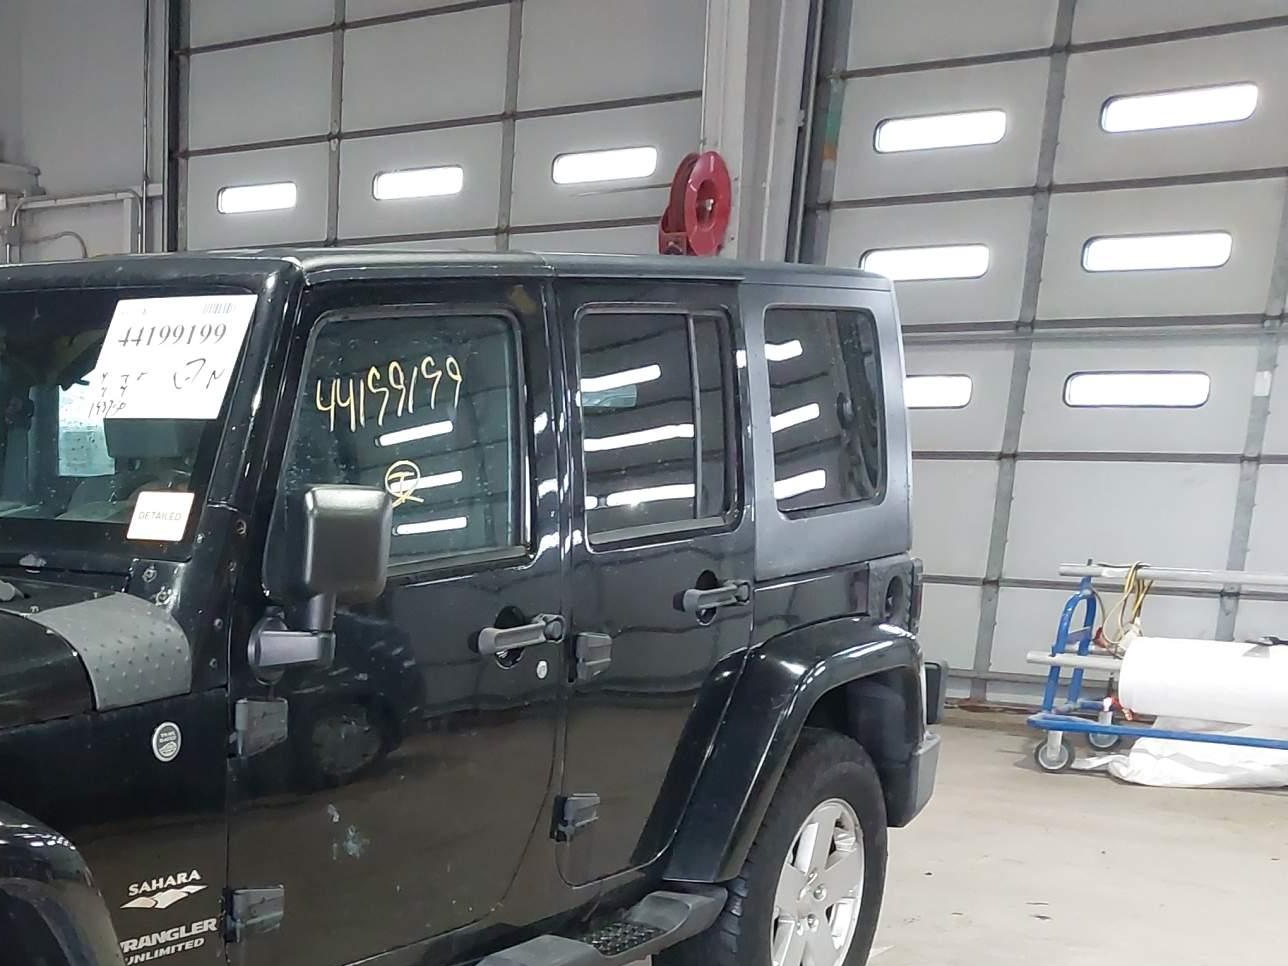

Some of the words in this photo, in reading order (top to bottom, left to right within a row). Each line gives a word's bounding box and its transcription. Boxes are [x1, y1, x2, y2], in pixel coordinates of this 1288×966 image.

[118, 323, 227, 347] 44199199
[316, 355, 463, 433] 44199199
[138, 511, 183, 521] DETAILED
[128, 869, 201, 896] SAHARA
[119, 917, 218, 953] RANGLER
